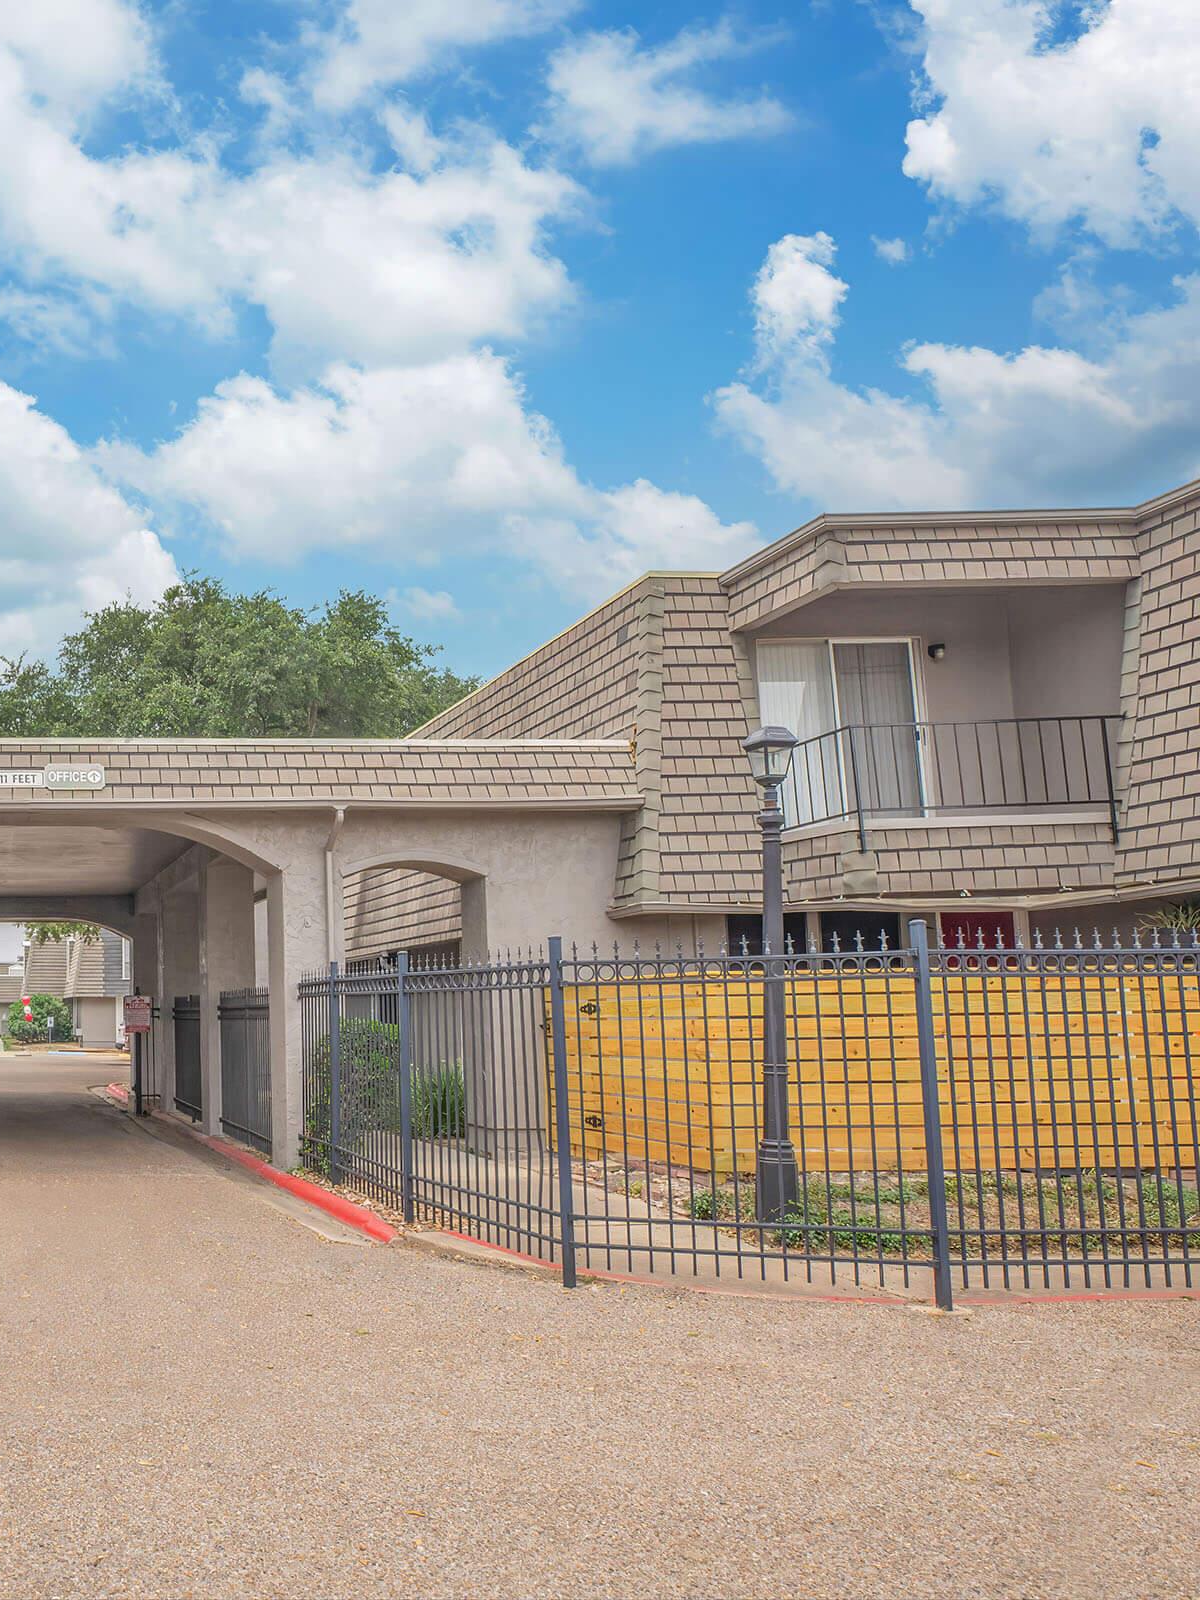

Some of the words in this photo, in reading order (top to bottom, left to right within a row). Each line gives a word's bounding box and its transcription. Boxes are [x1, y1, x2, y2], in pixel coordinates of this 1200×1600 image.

[0, 774, 8, 784] 11
[12, 774, 37, 784] FEET
[48, 771, 87, 782] OFFICE
